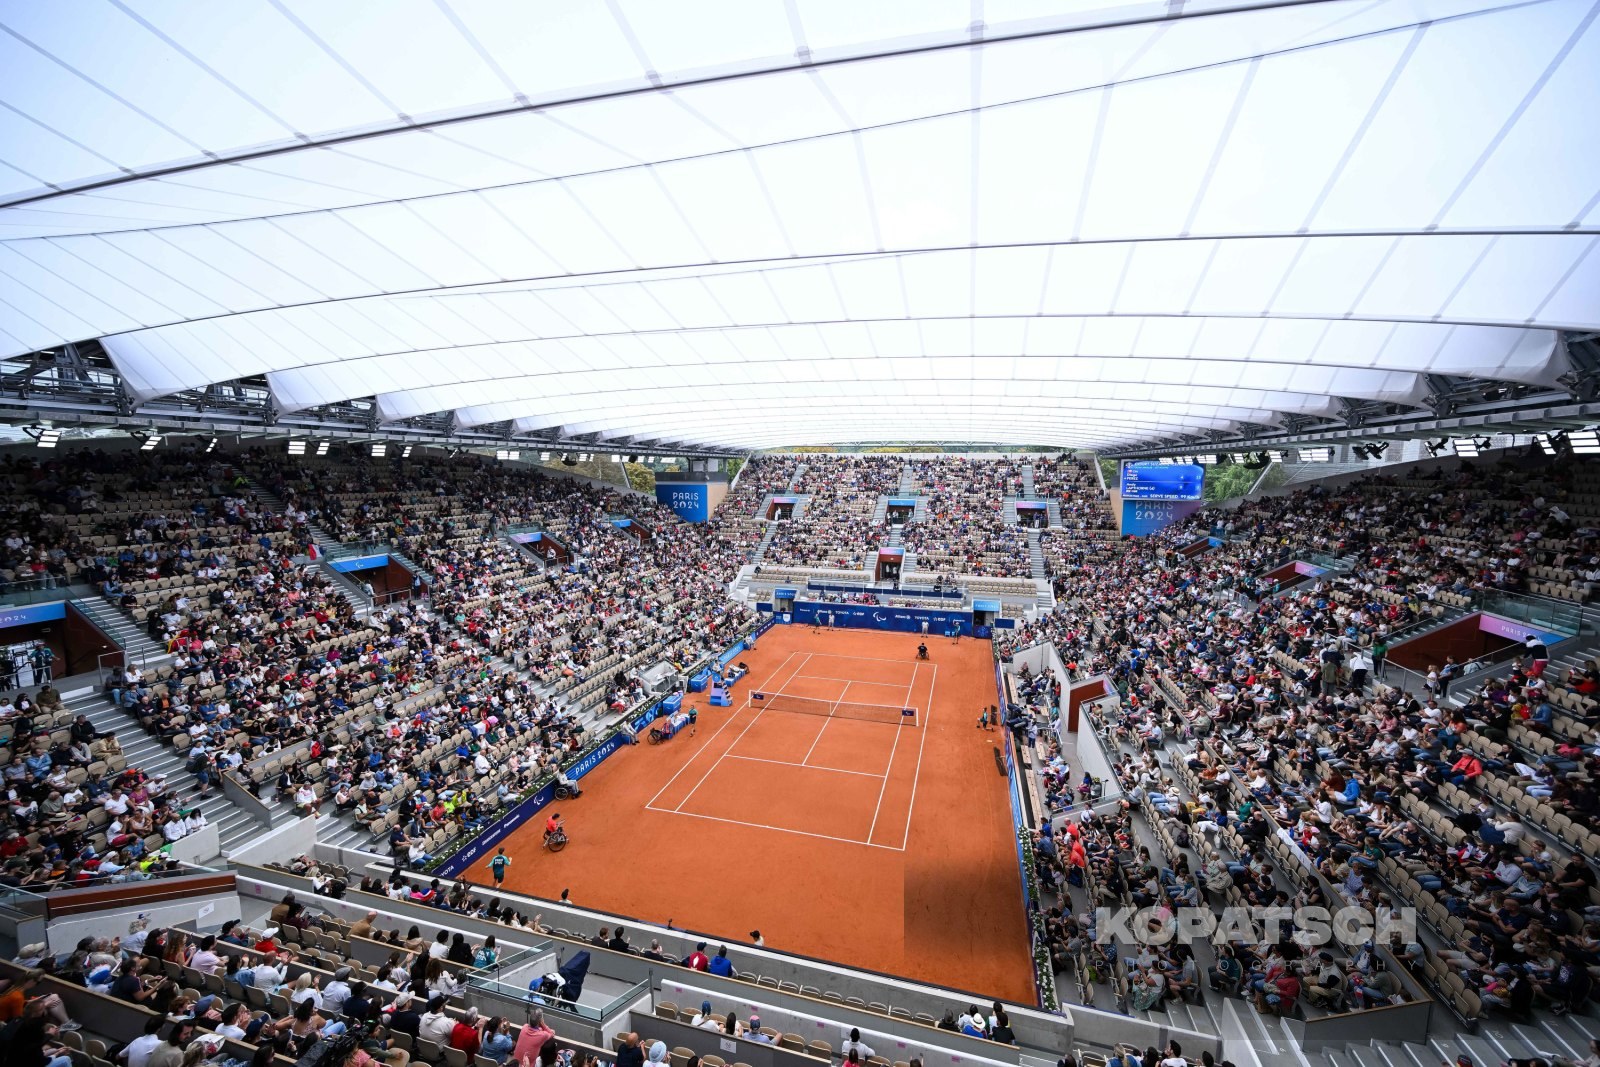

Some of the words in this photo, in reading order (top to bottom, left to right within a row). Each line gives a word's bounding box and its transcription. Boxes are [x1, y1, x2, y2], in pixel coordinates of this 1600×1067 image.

[673, 492, 699, 500] PARIS
[673, 501, 699, 509] 2024
[1135, 501, 1174, 510] PARIS
[1135, 510, 1173, 521] 2024
[0, 614, 26, 624] 024
[1501, 625, 1521, 636] PARIS
[575, 755, 597, 776] PARIS
[597, 742, 615, 759] 2024
[440, 865, 455, 877] YOTA
